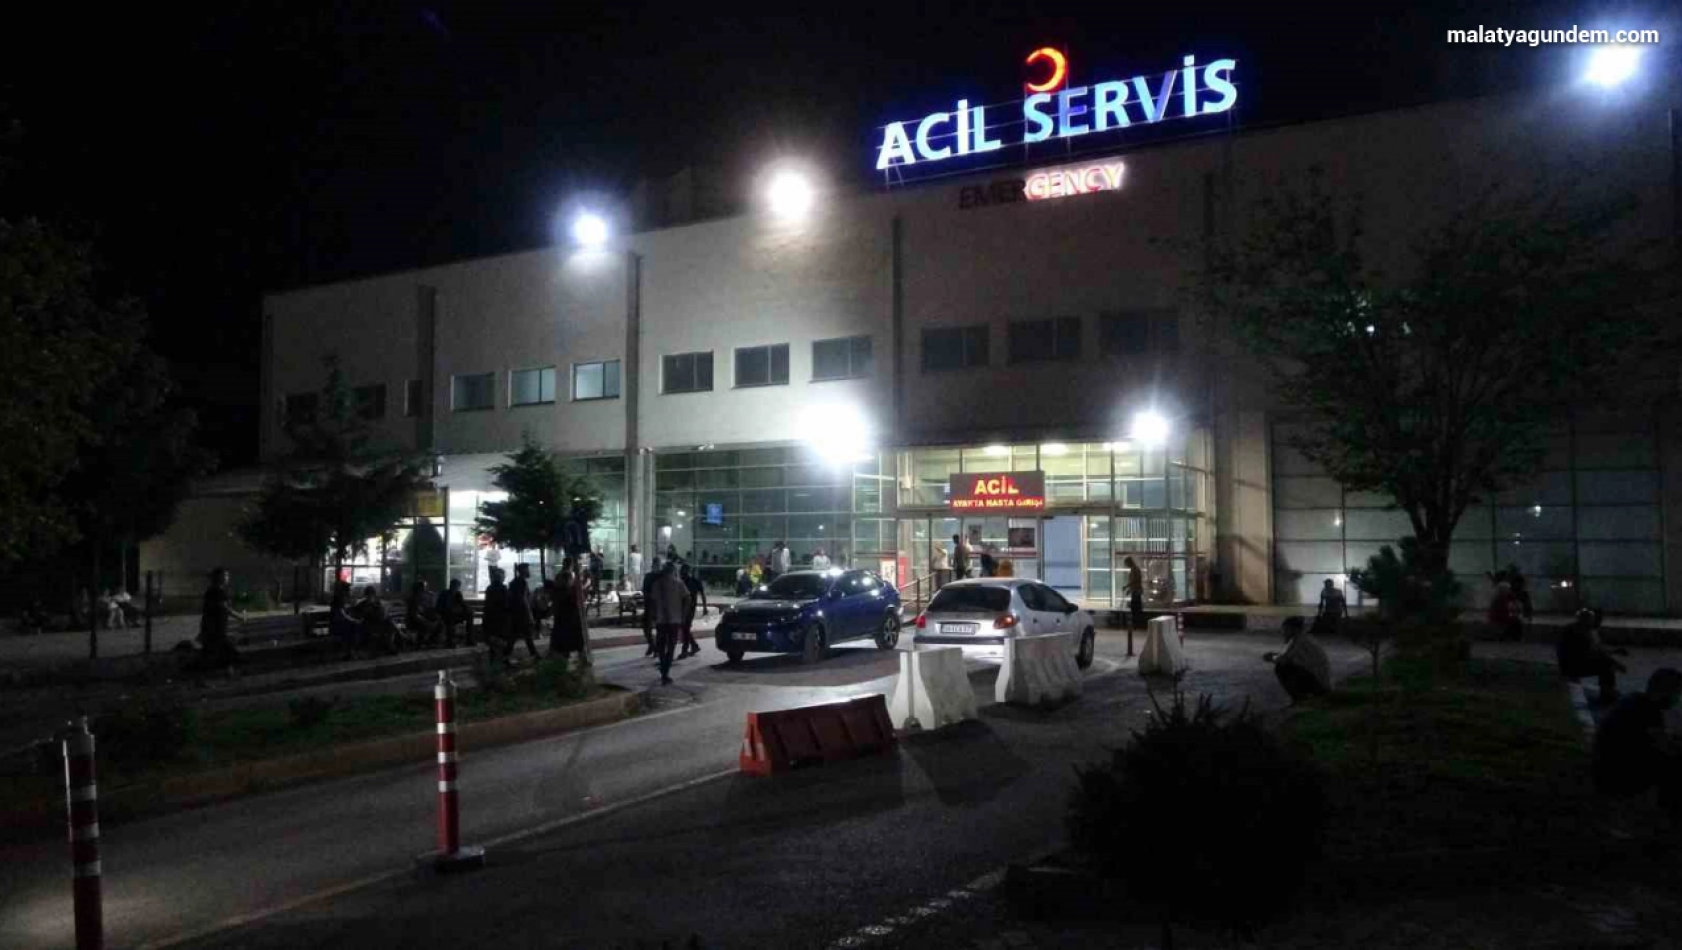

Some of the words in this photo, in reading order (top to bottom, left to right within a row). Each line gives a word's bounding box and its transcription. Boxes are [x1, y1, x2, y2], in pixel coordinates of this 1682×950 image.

[876, 99, 1002, 170] ACİL
[1024, 54, 1239, 143] SERVİS
[959, 161, 1126, 210] EMERGENCY
[974, 475, 1020, 495] ACİL
[986, 499, 1014, 507] HASTA
